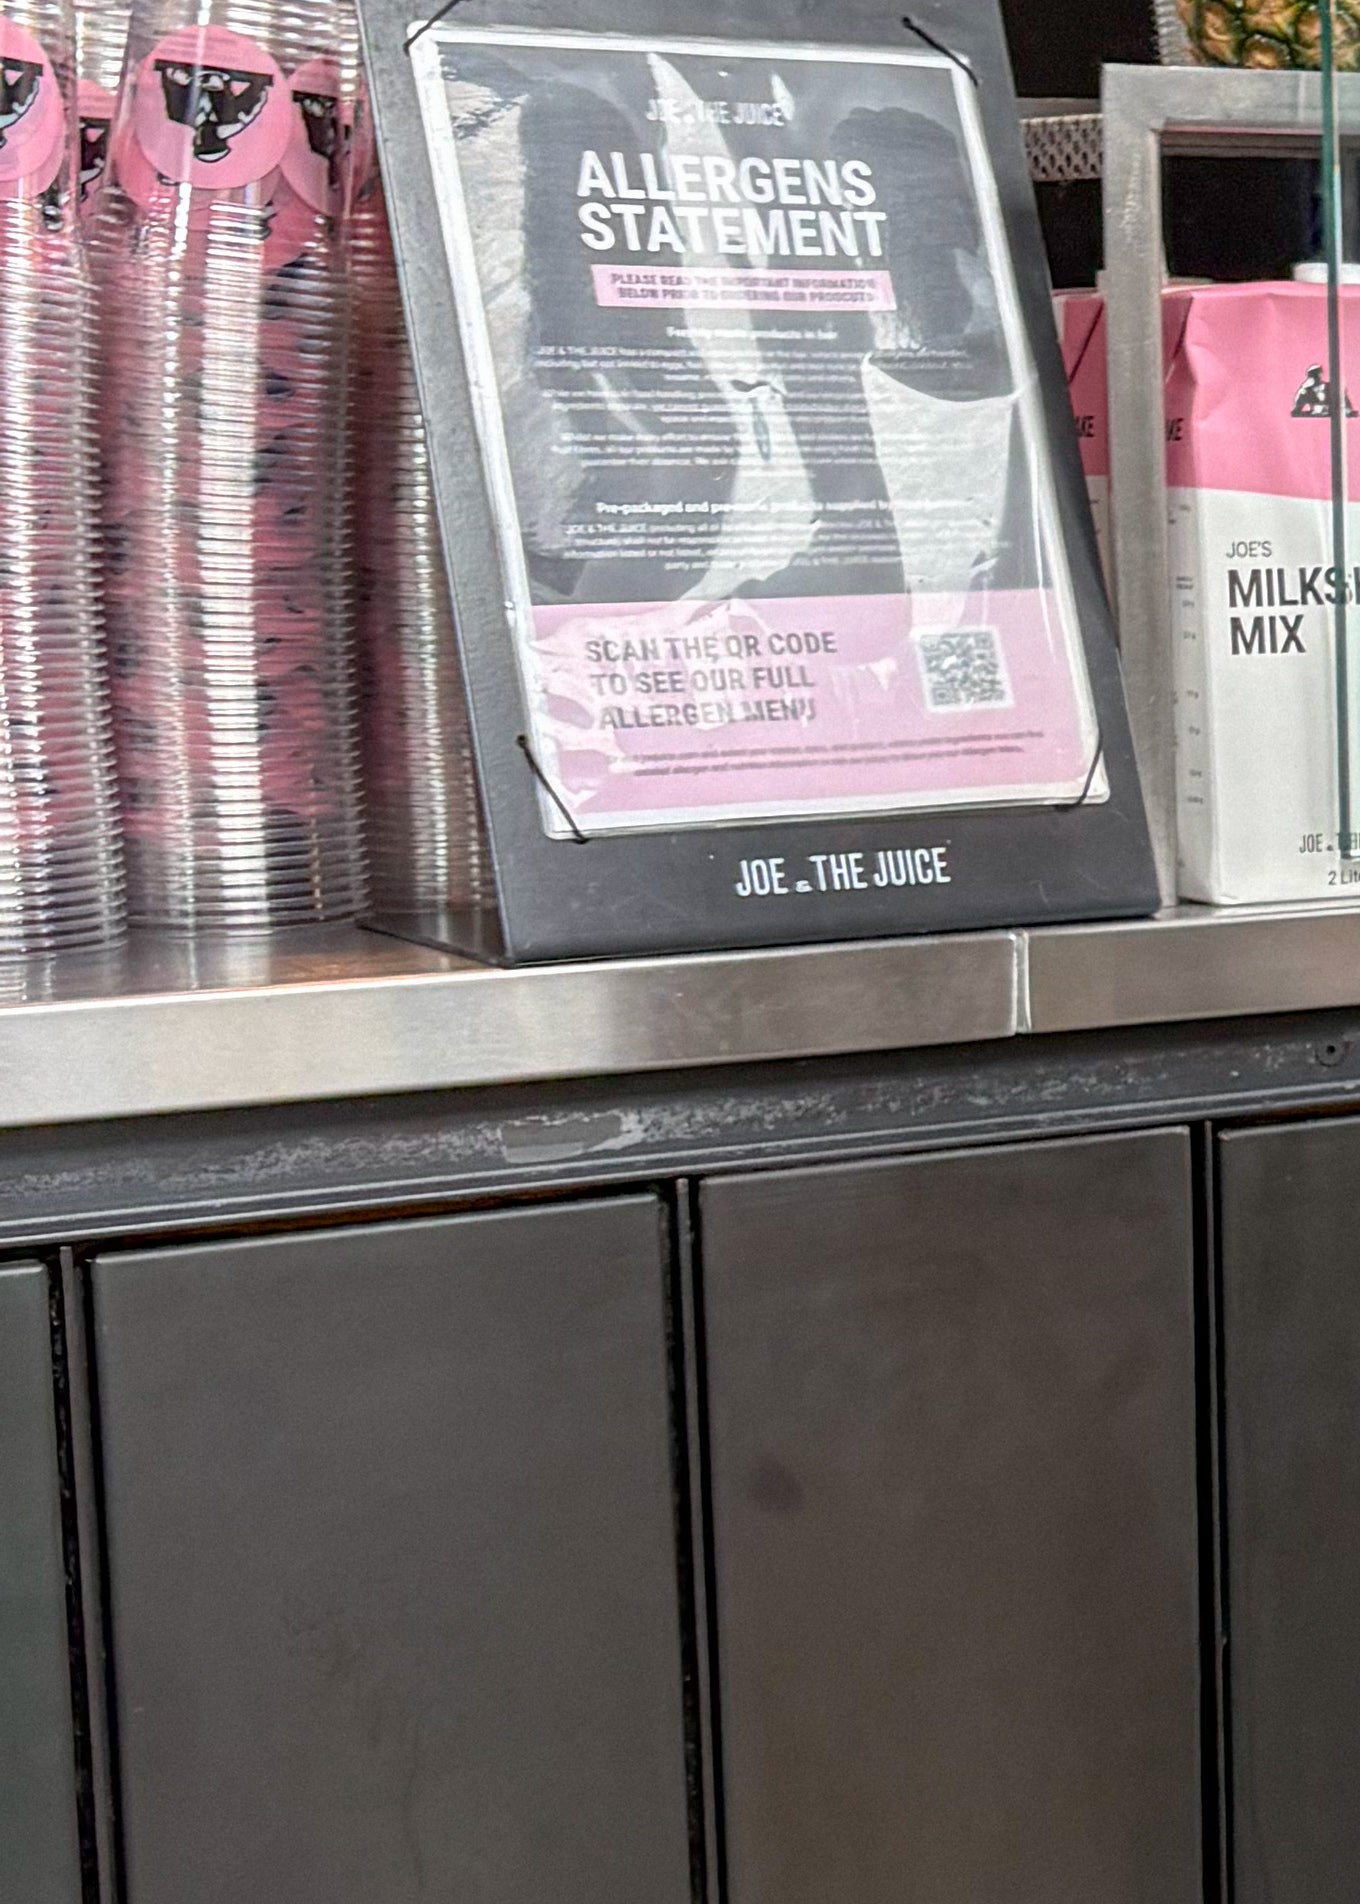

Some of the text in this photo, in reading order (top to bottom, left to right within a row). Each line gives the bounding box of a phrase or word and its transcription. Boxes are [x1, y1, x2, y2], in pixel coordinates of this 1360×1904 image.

[577, 150, 877, 207] ALLERGENS
[578, 202, 887, 257] STATEMENT
[1226, 540, 1272, 559] JOE'S
[586, 631, 838, 662] SCAN THE QR CODE
[1230, 614, 1307, 656] MIX
[590, 665, 816, 696] TO SEE OUR FULL
[601, 701, 736, 730] ALLERGEN
[1299, 833, 1323, 853] JOE
[735, 858, 789, 897] JOE
[808, 852, 869, 892] THE
[873, 847, 951, 889] JUICE
[1327, 870, 1337, 886] 2
